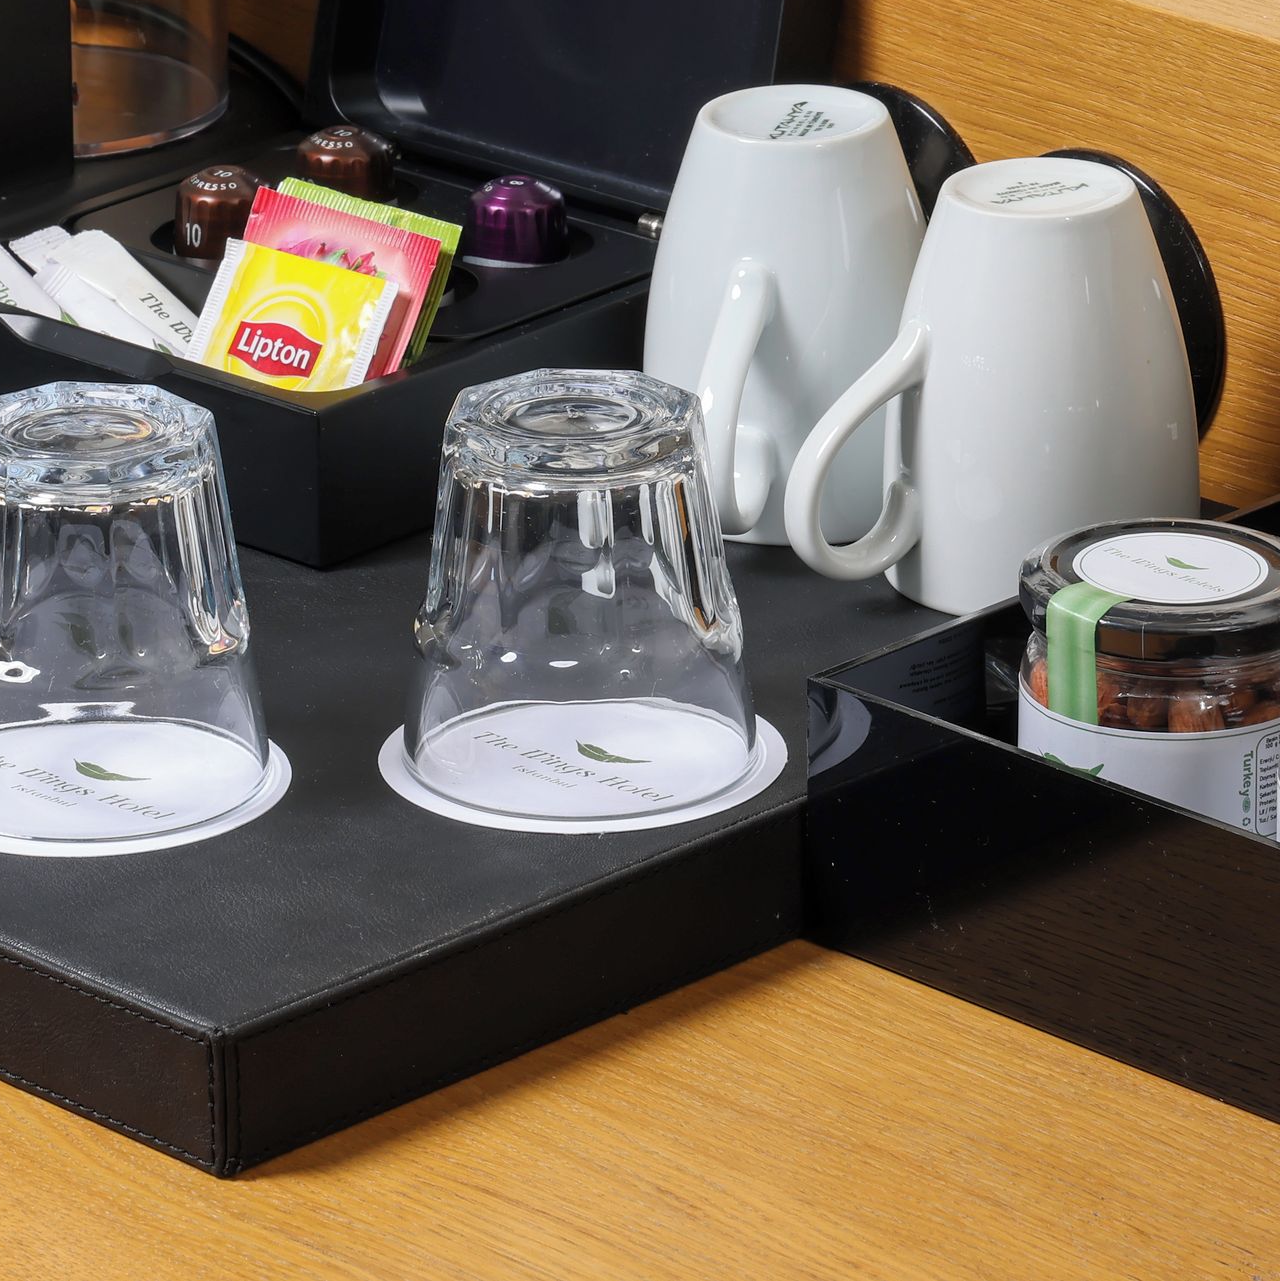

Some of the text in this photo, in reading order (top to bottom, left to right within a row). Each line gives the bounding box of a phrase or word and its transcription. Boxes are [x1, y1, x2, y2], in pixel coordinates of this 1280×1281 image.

[333, 129, 353, 137] 10
[185, 222, 202, 248] 10
[139, 292, 193, 344] The Wi
[237, 327, 311, 370] Lipton
[1104, 547, 1131, 559] The
[1131, 557, 1178, 577] Wings
[473, 731, 674, 802] The Wings Hotel
[1239, 750, 1254, 797] Turkey
[19, 768, 96, 796] Wings
[98, 794, 175, 820] Hotel
